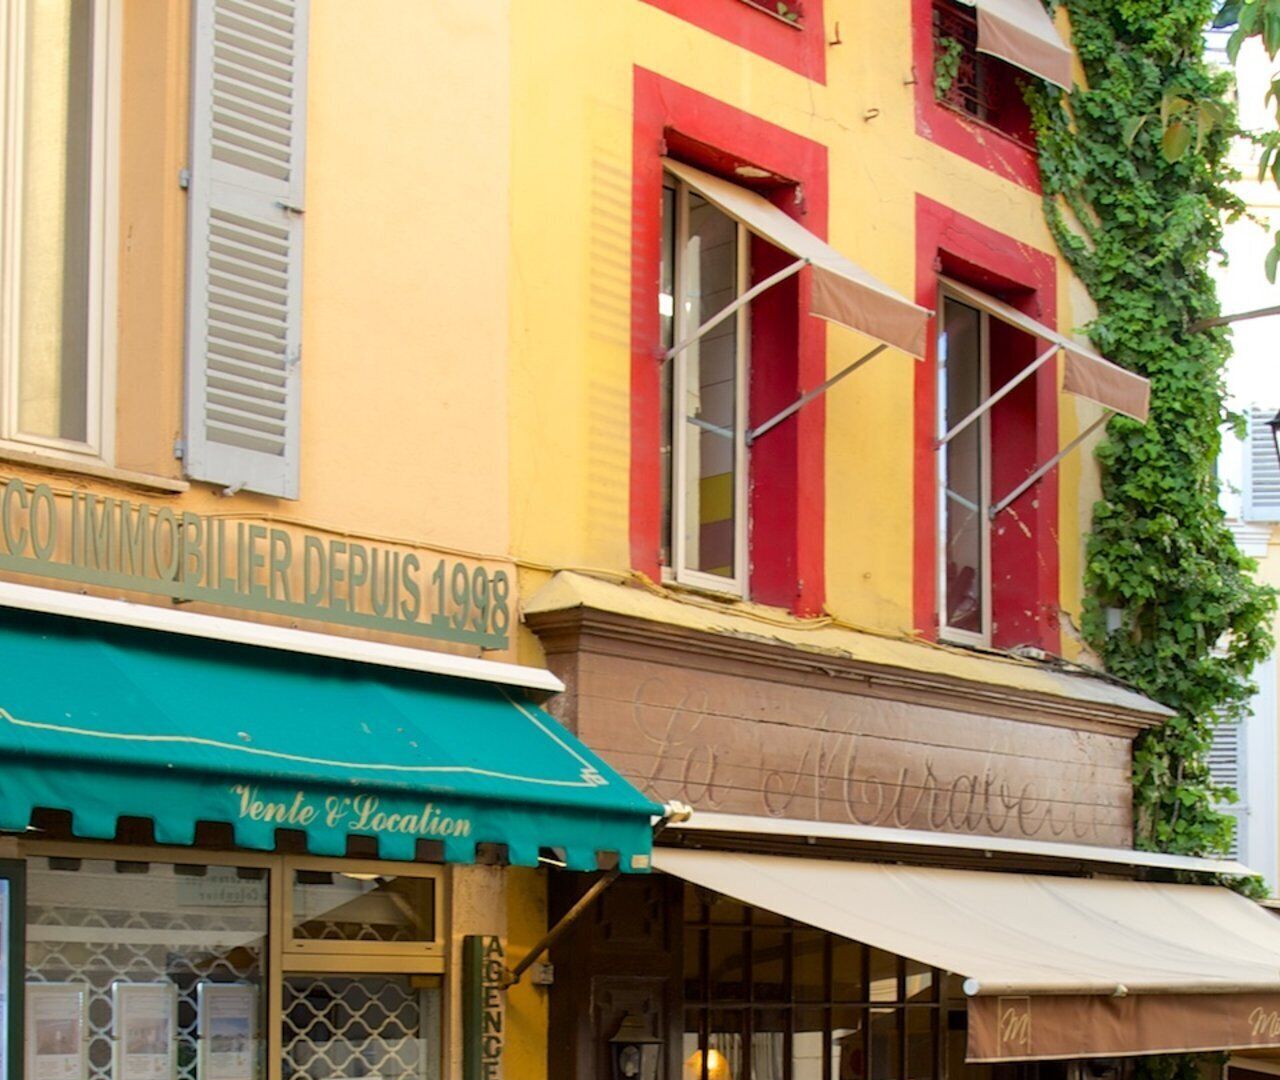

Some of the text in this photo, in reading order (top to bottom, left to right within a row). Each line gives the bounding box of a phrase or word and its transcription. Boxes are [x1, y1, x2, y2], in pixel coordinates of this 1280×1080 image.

[71, 490, 293, 602] IMMOBILIER
[303, 534, 422, 624] DEPUIS
[431, 556, 510, 637] 1998
[229, 784, 322, 826] Vente
[348, 794, 472, 838] Location
